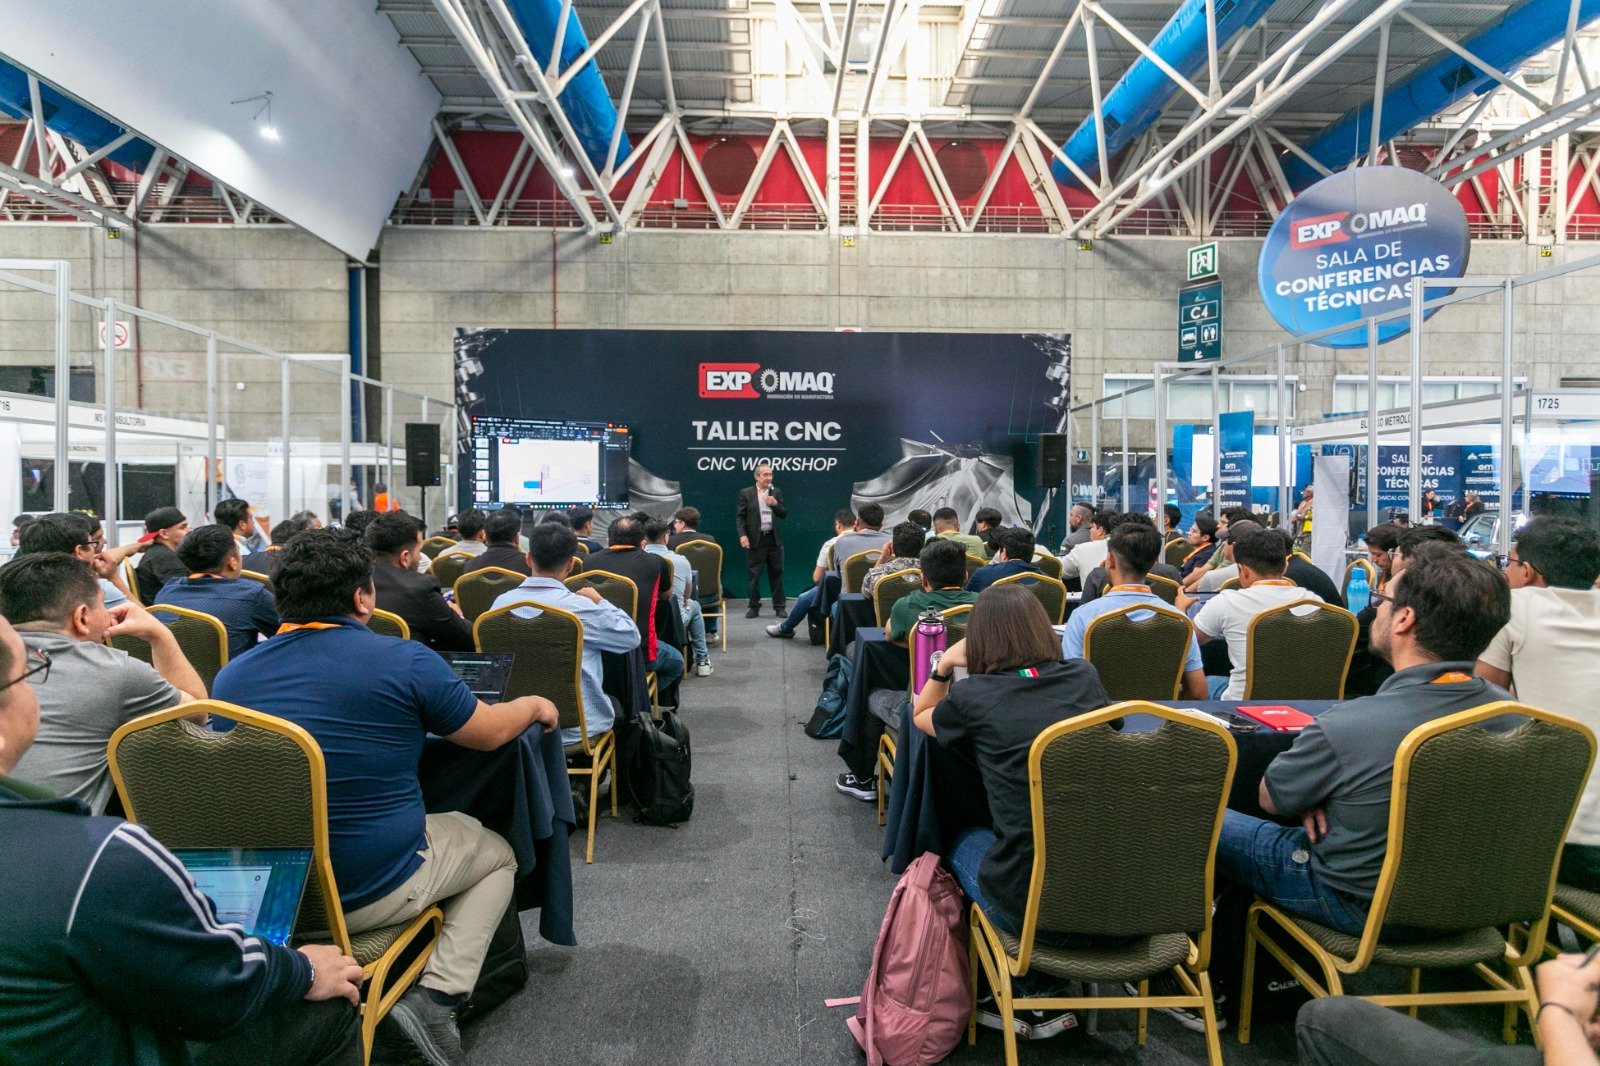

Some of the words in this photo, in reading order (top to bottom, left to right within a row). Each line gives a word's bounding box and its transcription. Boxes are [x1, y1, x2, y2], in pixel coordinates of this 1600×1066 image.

[1316, 248, 1368, 270] SALA
[1374, 240, 1402, 260] DE
[1275, 254, 1450, 296] CONFERENCIAS
[1190, 304, 1209, 320] C4
[1537, 398, 1560, 409] 1725
[692, 420, 780, 441] TALLER
[785, 421, 842, 441] CNC
[697, 457, 736, 471] CNC
[1391, 454, 1410, 464] SAL
[1267, 979, 1300, 991] CAESA
